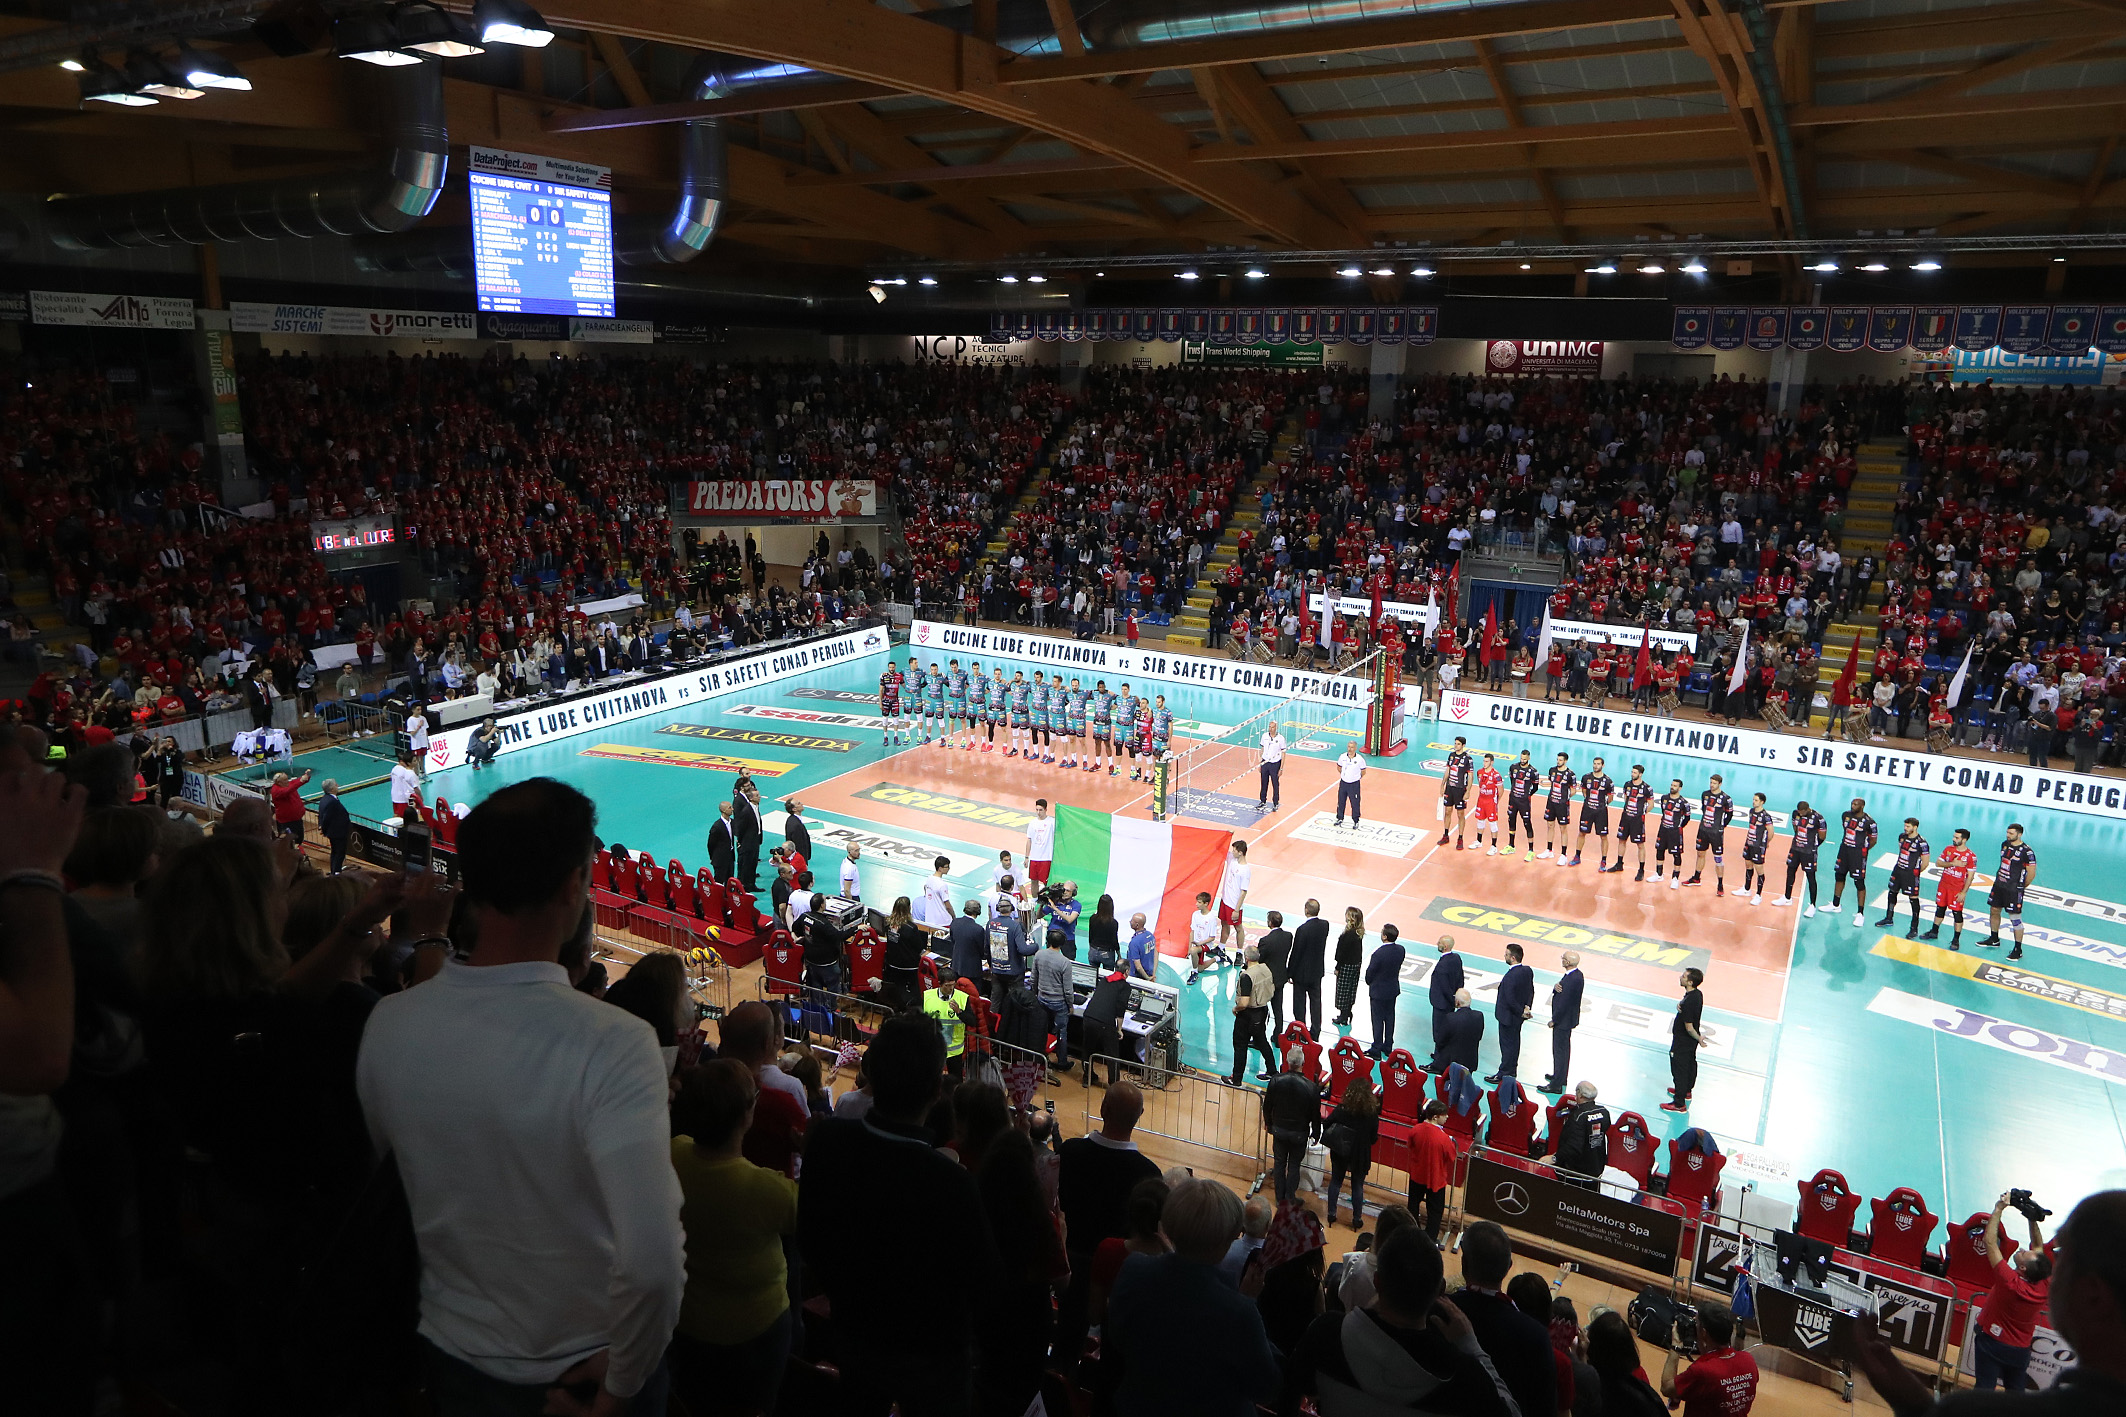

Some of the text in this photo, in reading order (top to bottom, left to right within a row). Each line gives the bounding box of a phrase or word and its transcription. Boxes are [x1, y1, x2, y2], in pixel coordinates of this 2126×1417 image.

[474, 152, 538, 171] DataProject.com
[530, 207, 540, 222] 0
[550, 210, 560, 224] 0
[33, 293, 87, 304] Ristorante
[153, 299, 191, 308] Pizzeria
[35, 314, 66, 324] Pesce
[275, 306, 326, 319] MARCHE
[164, 318, 193, 328] Legna
[271, 320, 323, 333] SISTEMI
[395, 314, 473, 329] moretti
[207, 331, 222, 377] BUTTALA
[914, 336, 968, 360] N.C.P.
[972, 345, 1006, 353] TECNICI
[1187, 346, 1201, 356] TWS
[1206, 347, 1271, 358] Trans World Shipping
[1564, 358, 1598, 366] MACERATA
[212, 374, 238, 397] GIÙ
[693, 480, 825, 512] PREDATORS
[918, 625, 930, 634] LUBE
[1550, 625, 1567, 633] CUCINE
[1667, 638, 1689, 646] PERUGIA
[943, 630, 987, 649] CUCINE
[993, 635, 1023, 655] LUBE
[1029, 640, 1106, 666] CIVITANOVA
[1142, 656, 1166, 674] SIR
[1173, 662, 1226, 682] SAFETY
[1233, 668, 1283, 690] CONAD
[1291, 677, 1358, 701] PERUGIA
[538, 708, 578, 735] LUBE
[583, 686, 668, 724] CIVITANOVA
[699, 674, 721, 693] SIR
[726, 660, 767, 686] SAFETY
[773, 650, 808, 674] CONAD
[813, 639, 856, 664] PERUGIA
[1451, 696, 1470, 708] LUBE
[660, 723, 850, 751] MALAGRIDA
[430, 739, 449, 753] LUBE
[1490, 703, 1556, 730] CUCINE
[1565, 713, 1612, 738] LUBE
[1621, 721, 1739, 755] CIVITANOVA
[1797, 746, 1833, 768] SIR
[1845, 752, 1932, 782] SAFETY
[1943, 765, 2024, 795] CONAD
[1154, 766, 1163, 798] BANCA
[870, 788, 1037, 828] CREDEM
[432, 860, 448, 875] Six
[1441, 906, 1693, 966] CREDEM
[1623, 1136, 1637, 1146] LUBE
[1688, 1154, 1703, 1165] LUBE
[1732, 1164, 1755, 1173] VIDEO
[1743, 1161, 1777, 1174] SERIE
[1820, 1196, 1837, 1206] LUBE
[1558, 1201, 1650, 1237] DeltaMotors Spa
[1895, 1214, 1914, 1226] LUBE
[1556, 1214, 1621, 1239] Montecosaro Scalo (MC)
[1555, 1220, 1564, 1228] Via
[1565, 1223, 1578, 1232] della
[1614, 1238, 1624, 1247] Tel.
[1624, 1242, 1640, 1251] 0733
[1874, 1285, 1936, 1315] taverna
[1798, 1304, 1834, 1316] VOLLEY
[1795, 1308, 1833, 1332] LUBE
[1720, 1373, 1753, 1386] UNA GRANDE
[1726, 1382, 1750, 1393] SQUADRA
